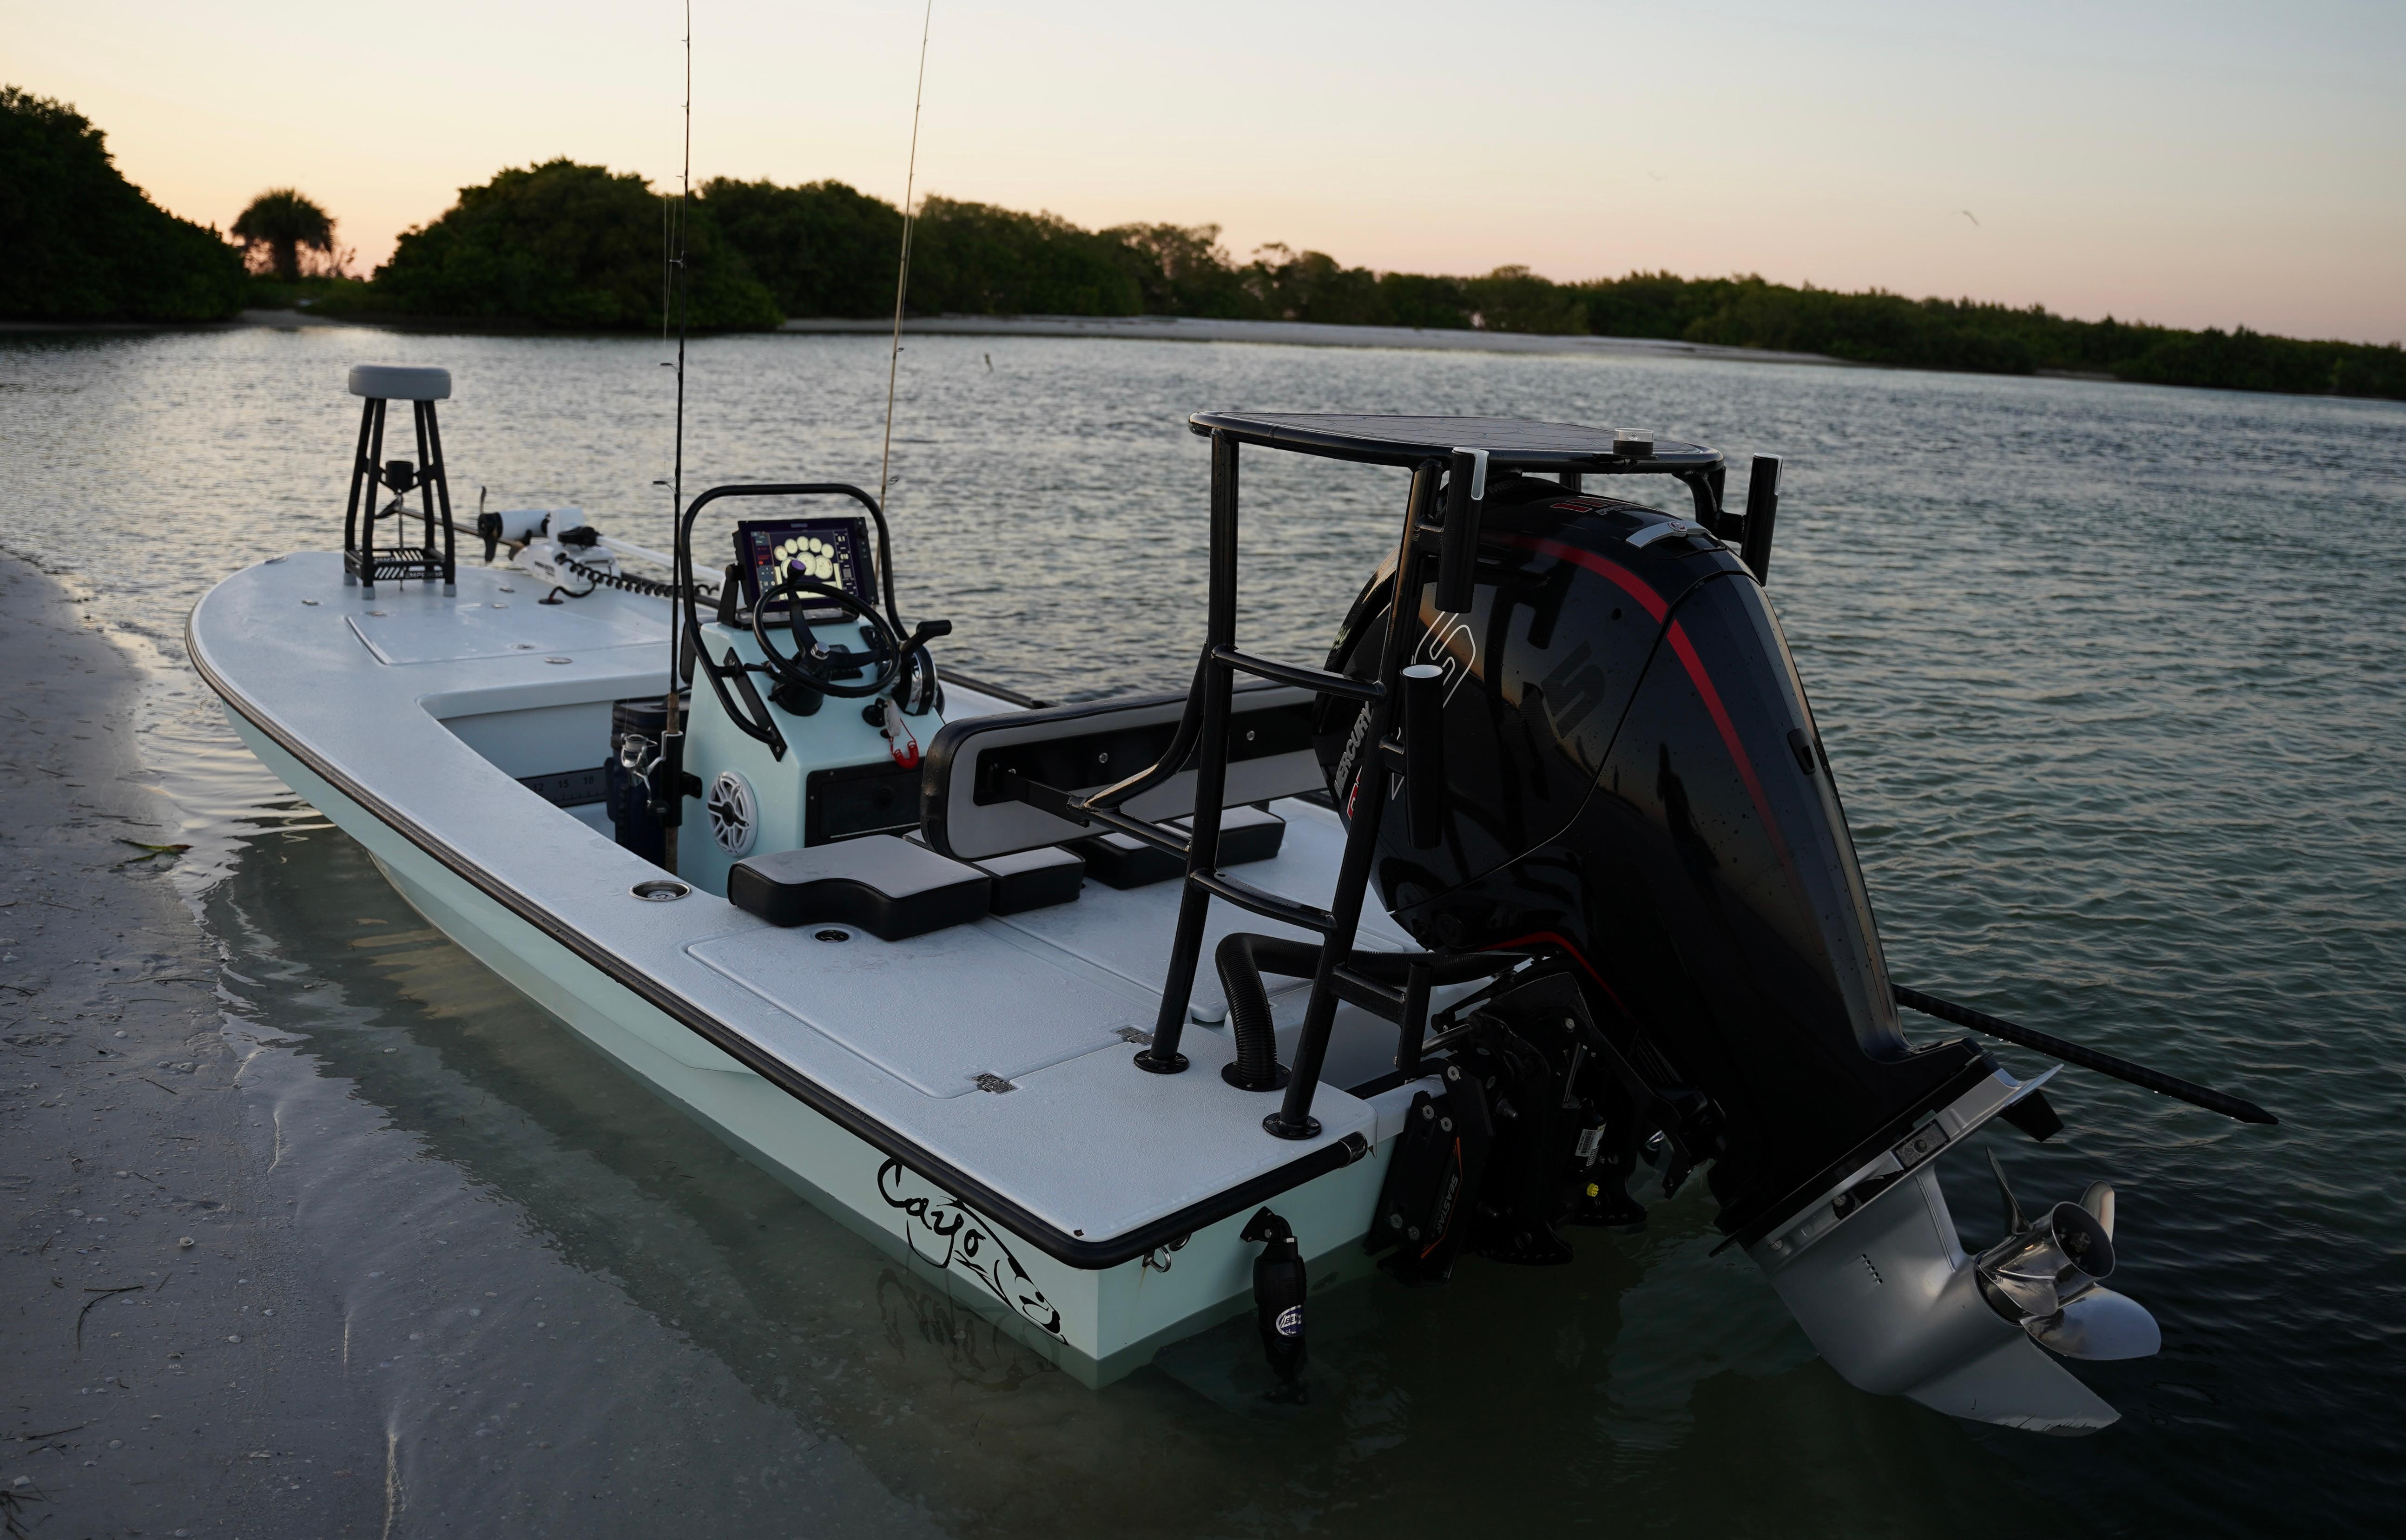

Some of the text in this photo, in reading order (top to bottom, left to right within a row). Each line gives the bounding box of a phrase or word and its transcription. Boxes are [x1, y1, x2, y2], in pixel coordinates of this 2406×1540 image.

[533, 783, 544, 792] 12
[559, 779, 569, 789] 15
[1333, 700, 1371, 800] MERCURY
[877, 1158, 986, 1268] Cayo
[1436, 1174, 1458, 1234] SEASTAR
